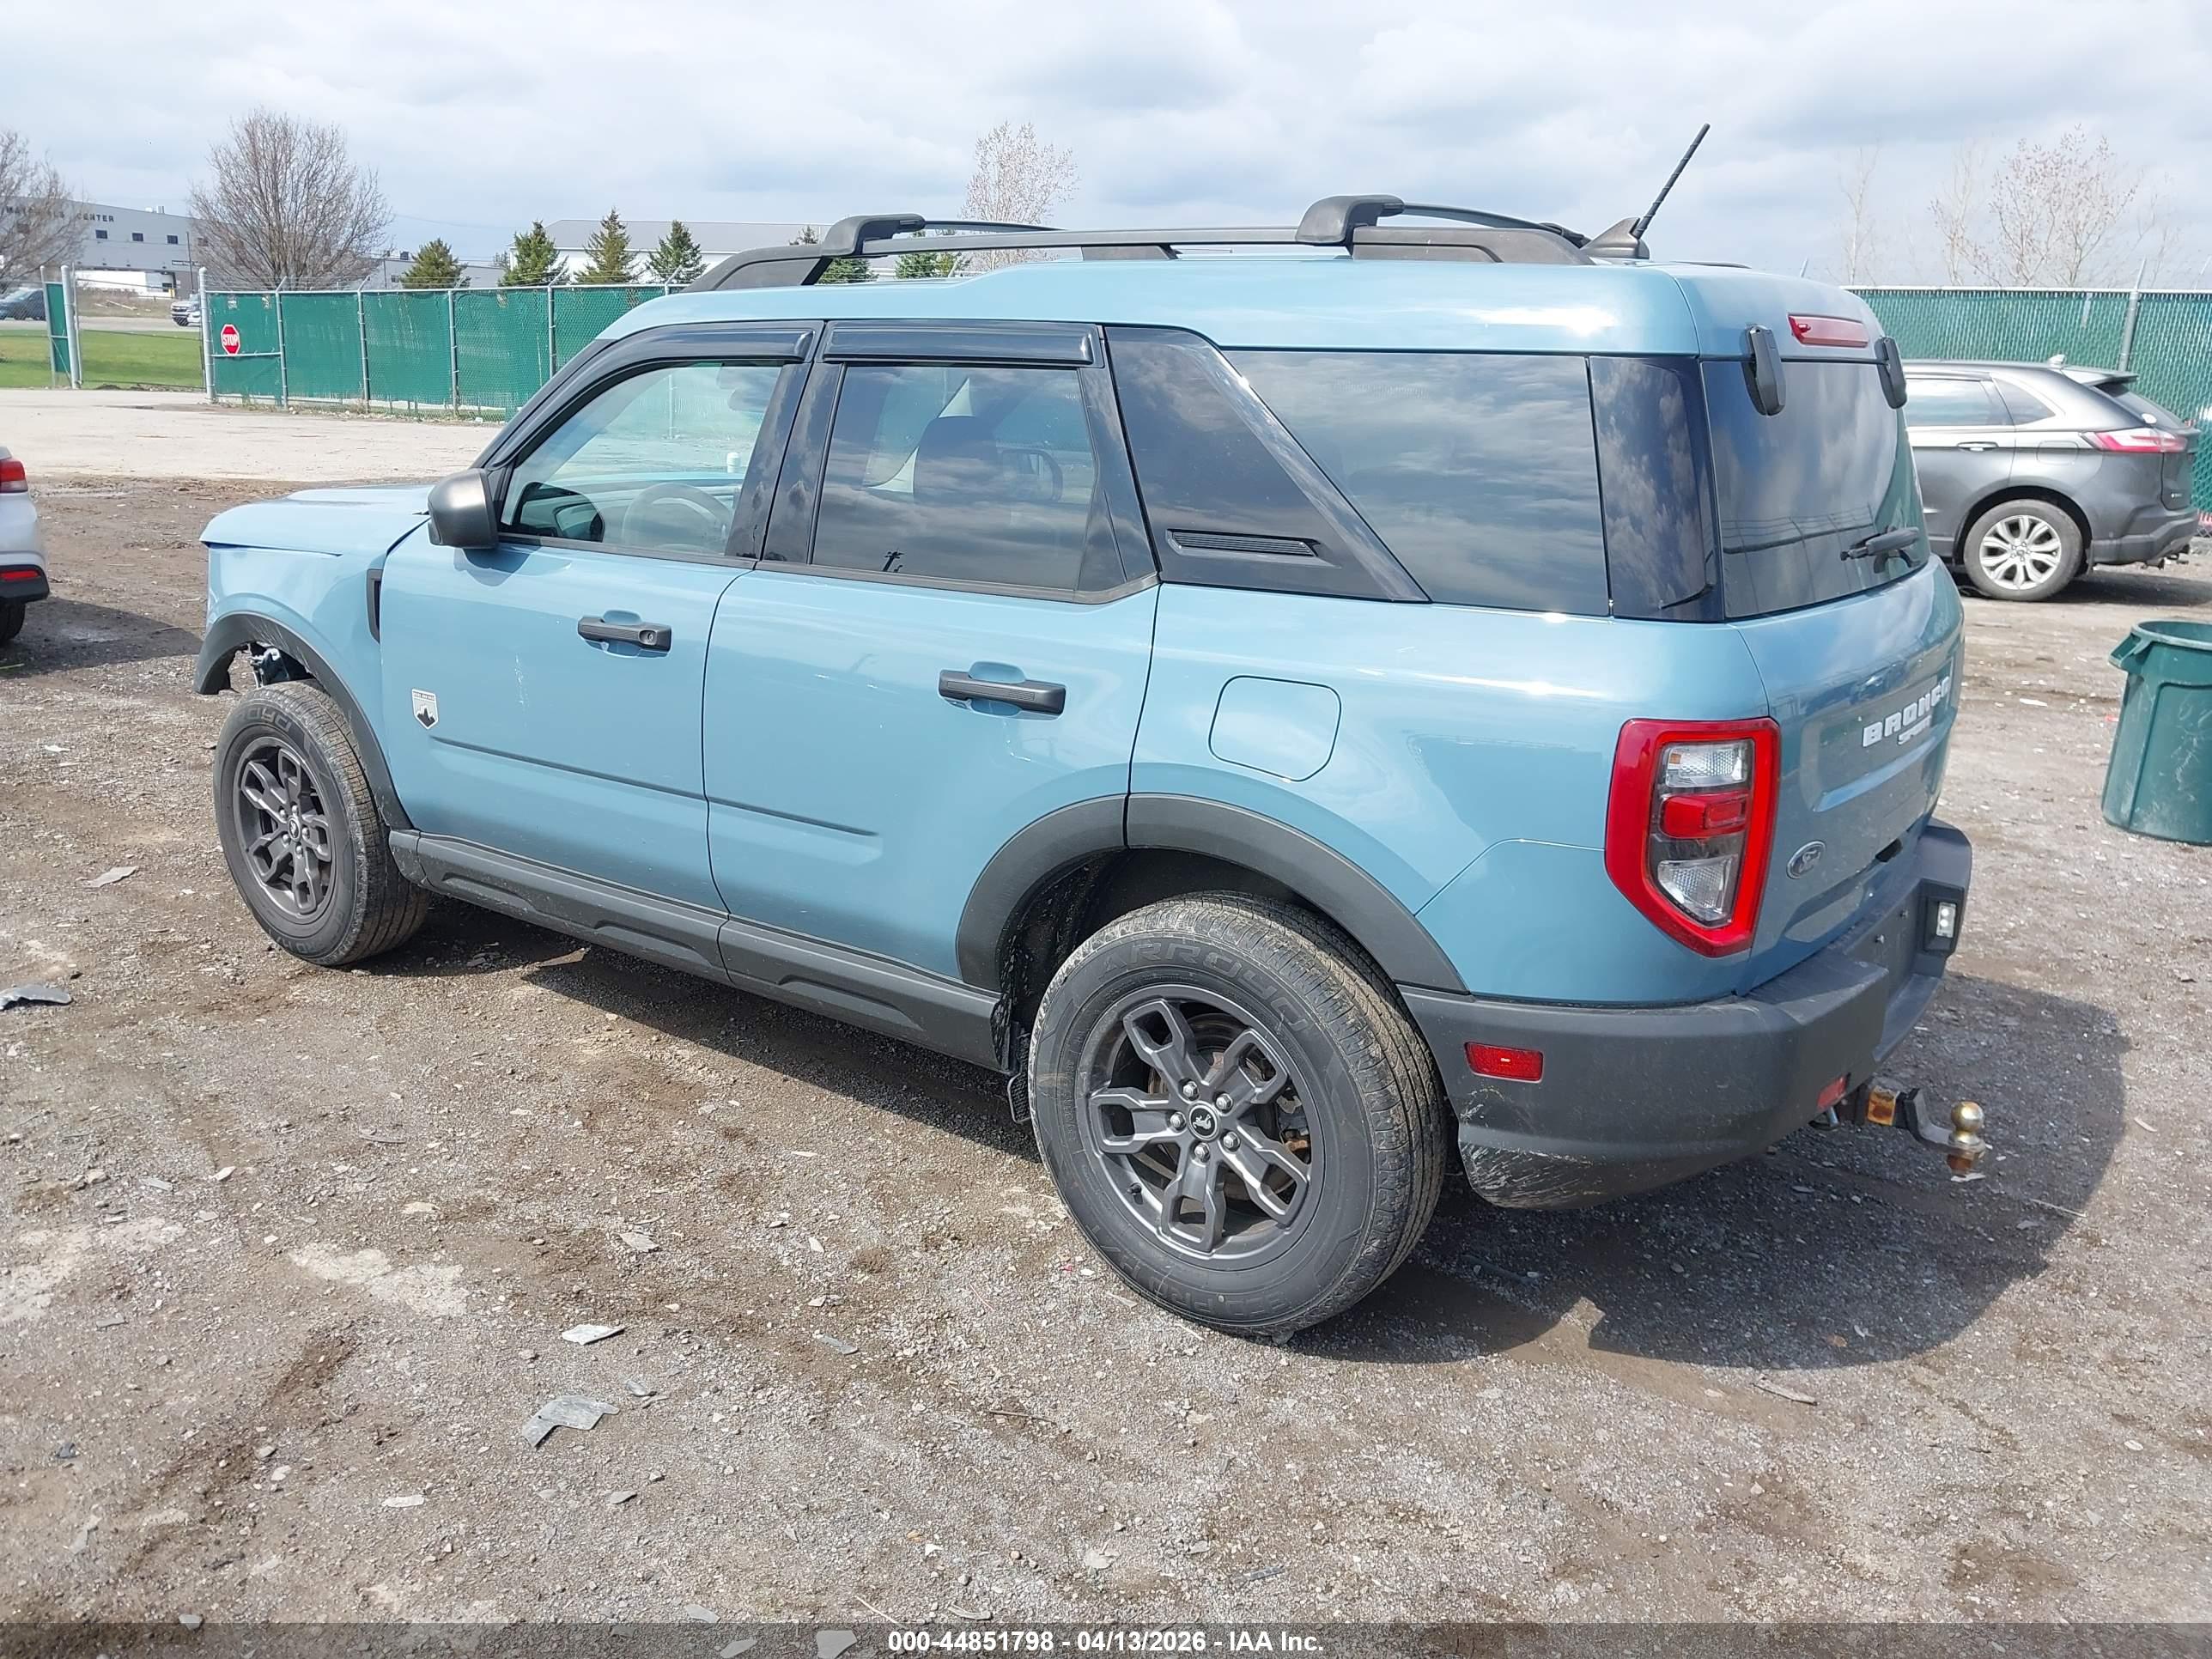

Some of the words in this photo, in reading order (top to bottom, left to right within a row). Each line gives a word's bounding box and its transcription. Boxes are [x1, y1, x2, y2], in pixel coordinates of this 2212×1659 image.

[76, 212, 114, 222] CENTER
[222, 333, 238, 346] STOP
[1863, 676, 1950, 748] BRONCO
[1097, 941, 1310, 1032] ARROYO
